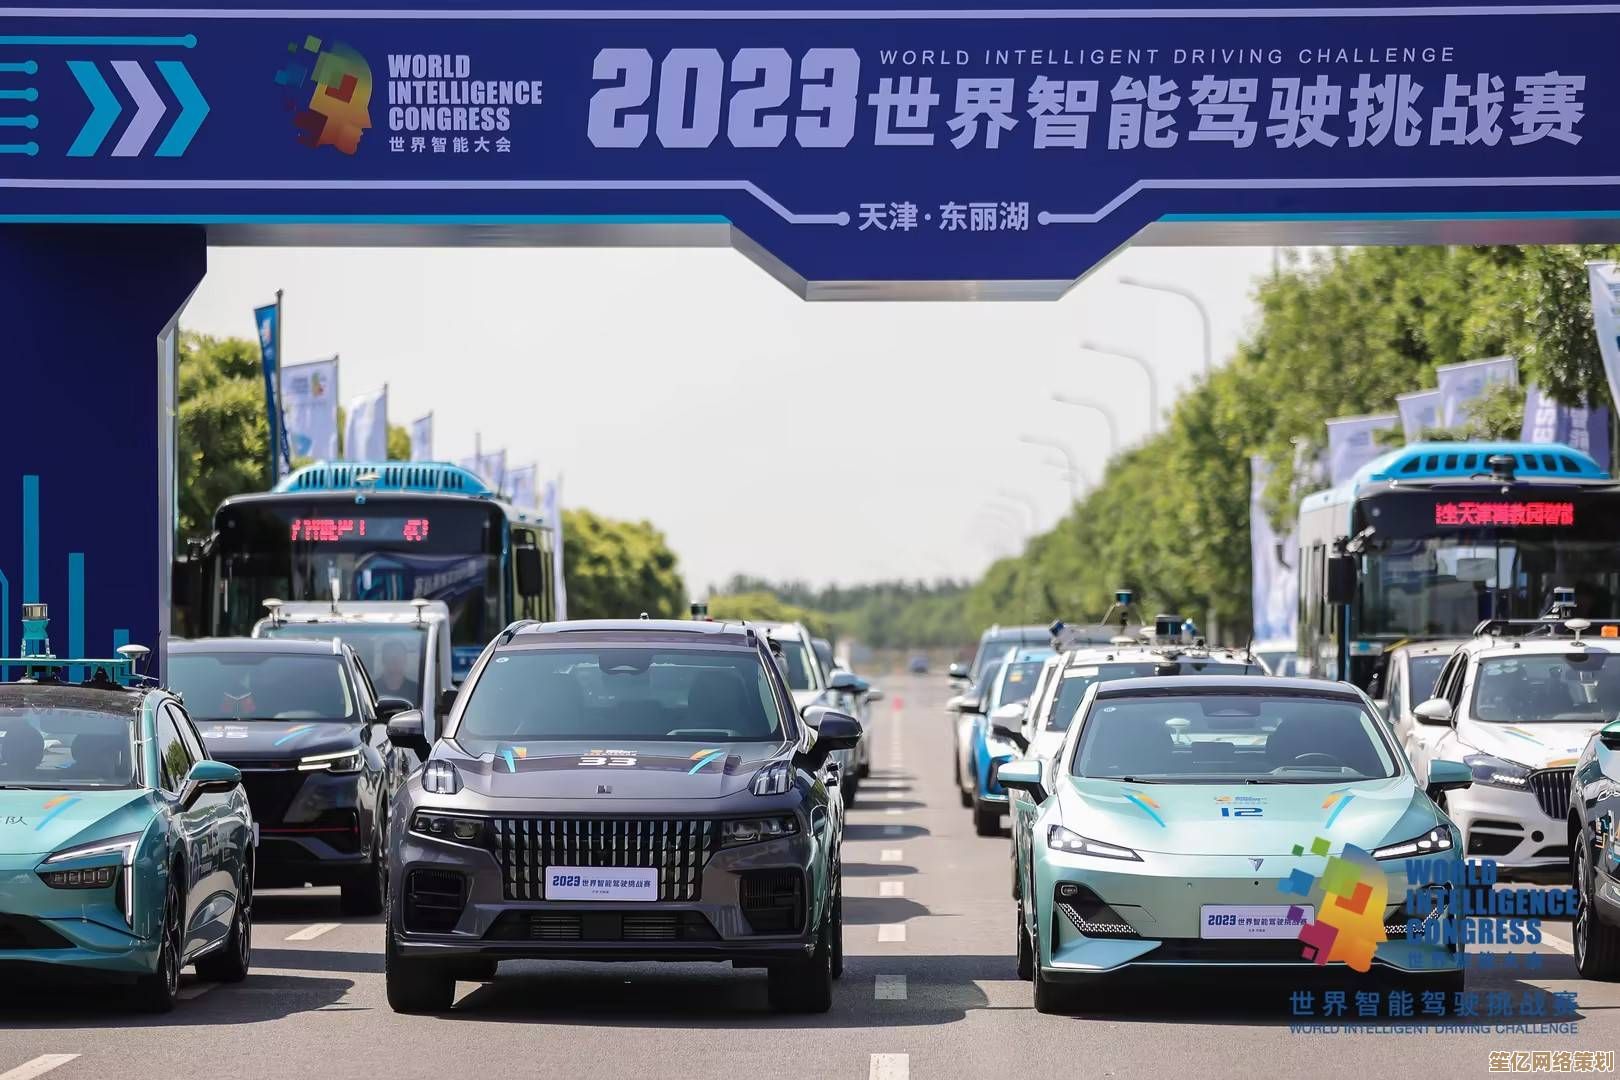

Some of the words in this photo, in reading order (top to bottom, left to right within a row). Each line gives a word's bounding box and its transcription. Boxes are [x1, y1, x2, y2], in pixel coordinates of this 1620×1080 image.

[880, 50, 970, 65] WORLD
[985, 49, 1159, 64] INTELLIGENT
[1173, 48, 1283, 64] DRIVING
[1299, 47, 1455, 63] CHALLENGE
[388, 54, 471, 78] WORLD
[388, 80, 543, 105] INTELLIGENCE
[587, 47, 861, 149] 2023
[867, 70, 1587, 150] 世界智能驾驶挑战赛
[388, 106, 511, 131] CONGRESS
[388, 136, 512, 153] 世界智能大会
[858, 200, 1029, 232] 天津·东丽湖
[577, 757, 638, 766] 33
[1221, 807, 1264, 817] 12
[552, 875, 581, 887] 2023
[1208, 914, 1237, 926] 2023
